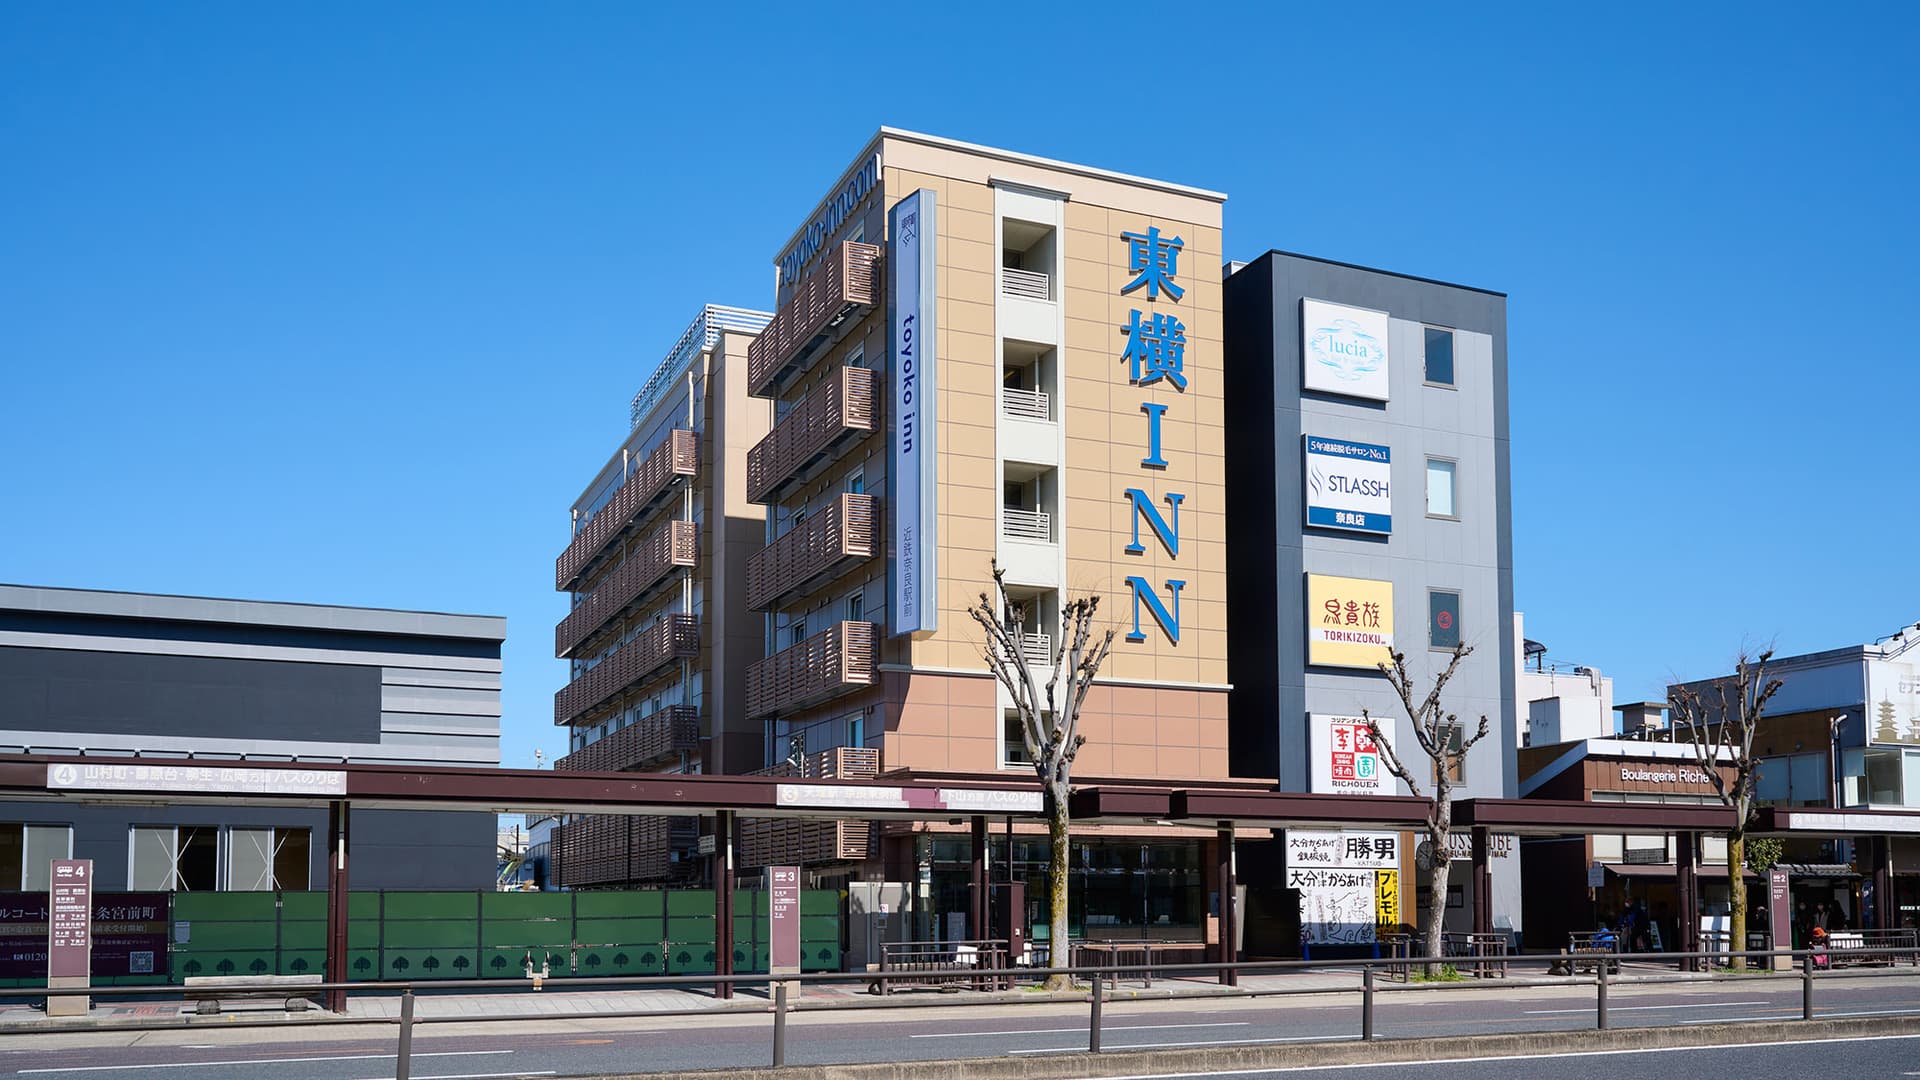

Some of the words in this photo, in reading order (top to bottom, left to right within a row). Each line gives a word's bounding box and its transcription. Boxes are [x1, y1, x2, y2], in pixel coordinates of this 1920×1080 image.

[780, 152, 882, 286] toyoko-inn.com
[1328, 334, 1368, 359] lucia
[901, 314, 915, 405] toyoko
[903, 412, 915, 454] inn
[1328, 474, 1389, 499] STLASSH
[1335, 511, 1365, 527] 奈良店
[1324, 630, 1381, 645] TORIKIZOKU
[1332, 780, 1379, 788] RICHOUEN
[1621, 768, 1676, 785] Boulangerie
[1678, 768, 1709, 784] Riche
[1345, 836, 1395, 860] 勝男
[75, 866, 84, 878] 4
[788, 871, 795, 882] 3
[1781, 874, 1786, 882] 2
[92, 906, 157, 920] 条宮前町
